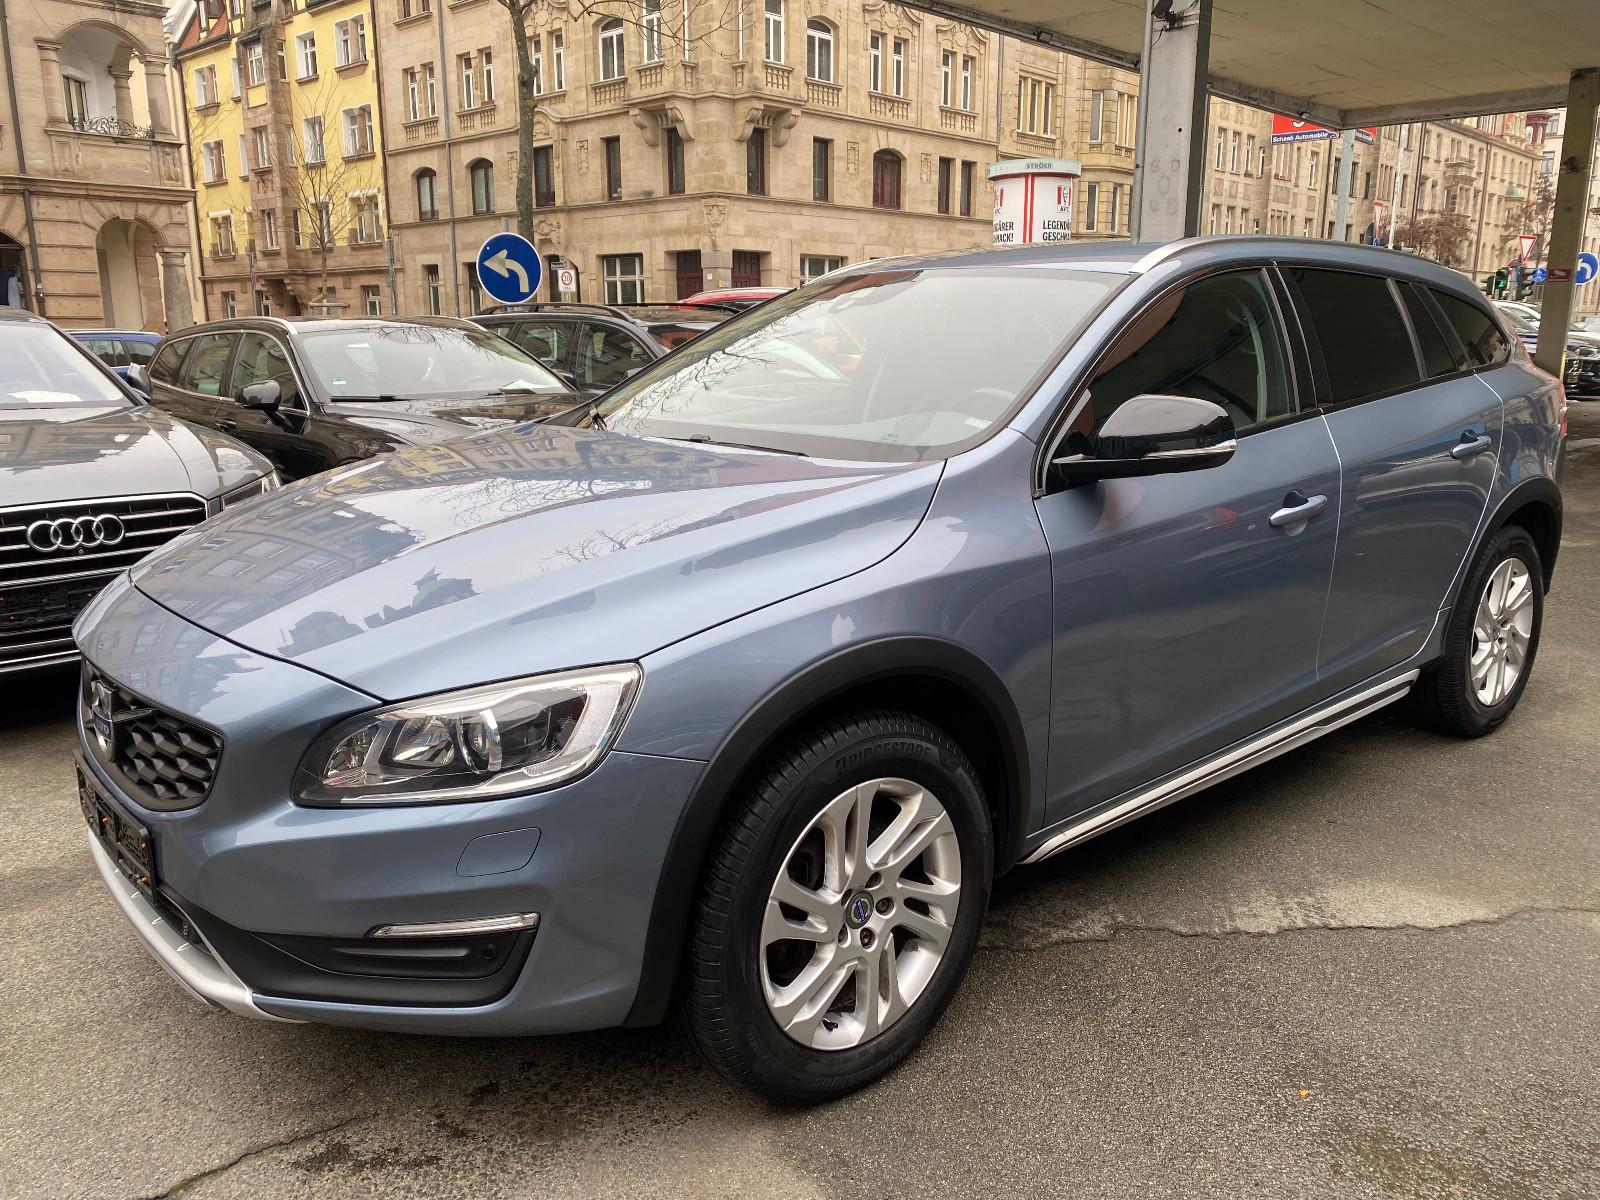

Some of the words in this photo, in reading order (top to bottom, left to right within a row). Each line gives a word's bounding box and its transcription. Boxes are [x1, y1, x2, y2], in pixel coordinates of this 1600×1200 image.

[1295, 132, 1328, 141] Automobile
[1026, 161, 1052, 169] STRÖER
[835, 741, 932, 769] BRIDGESTONE
